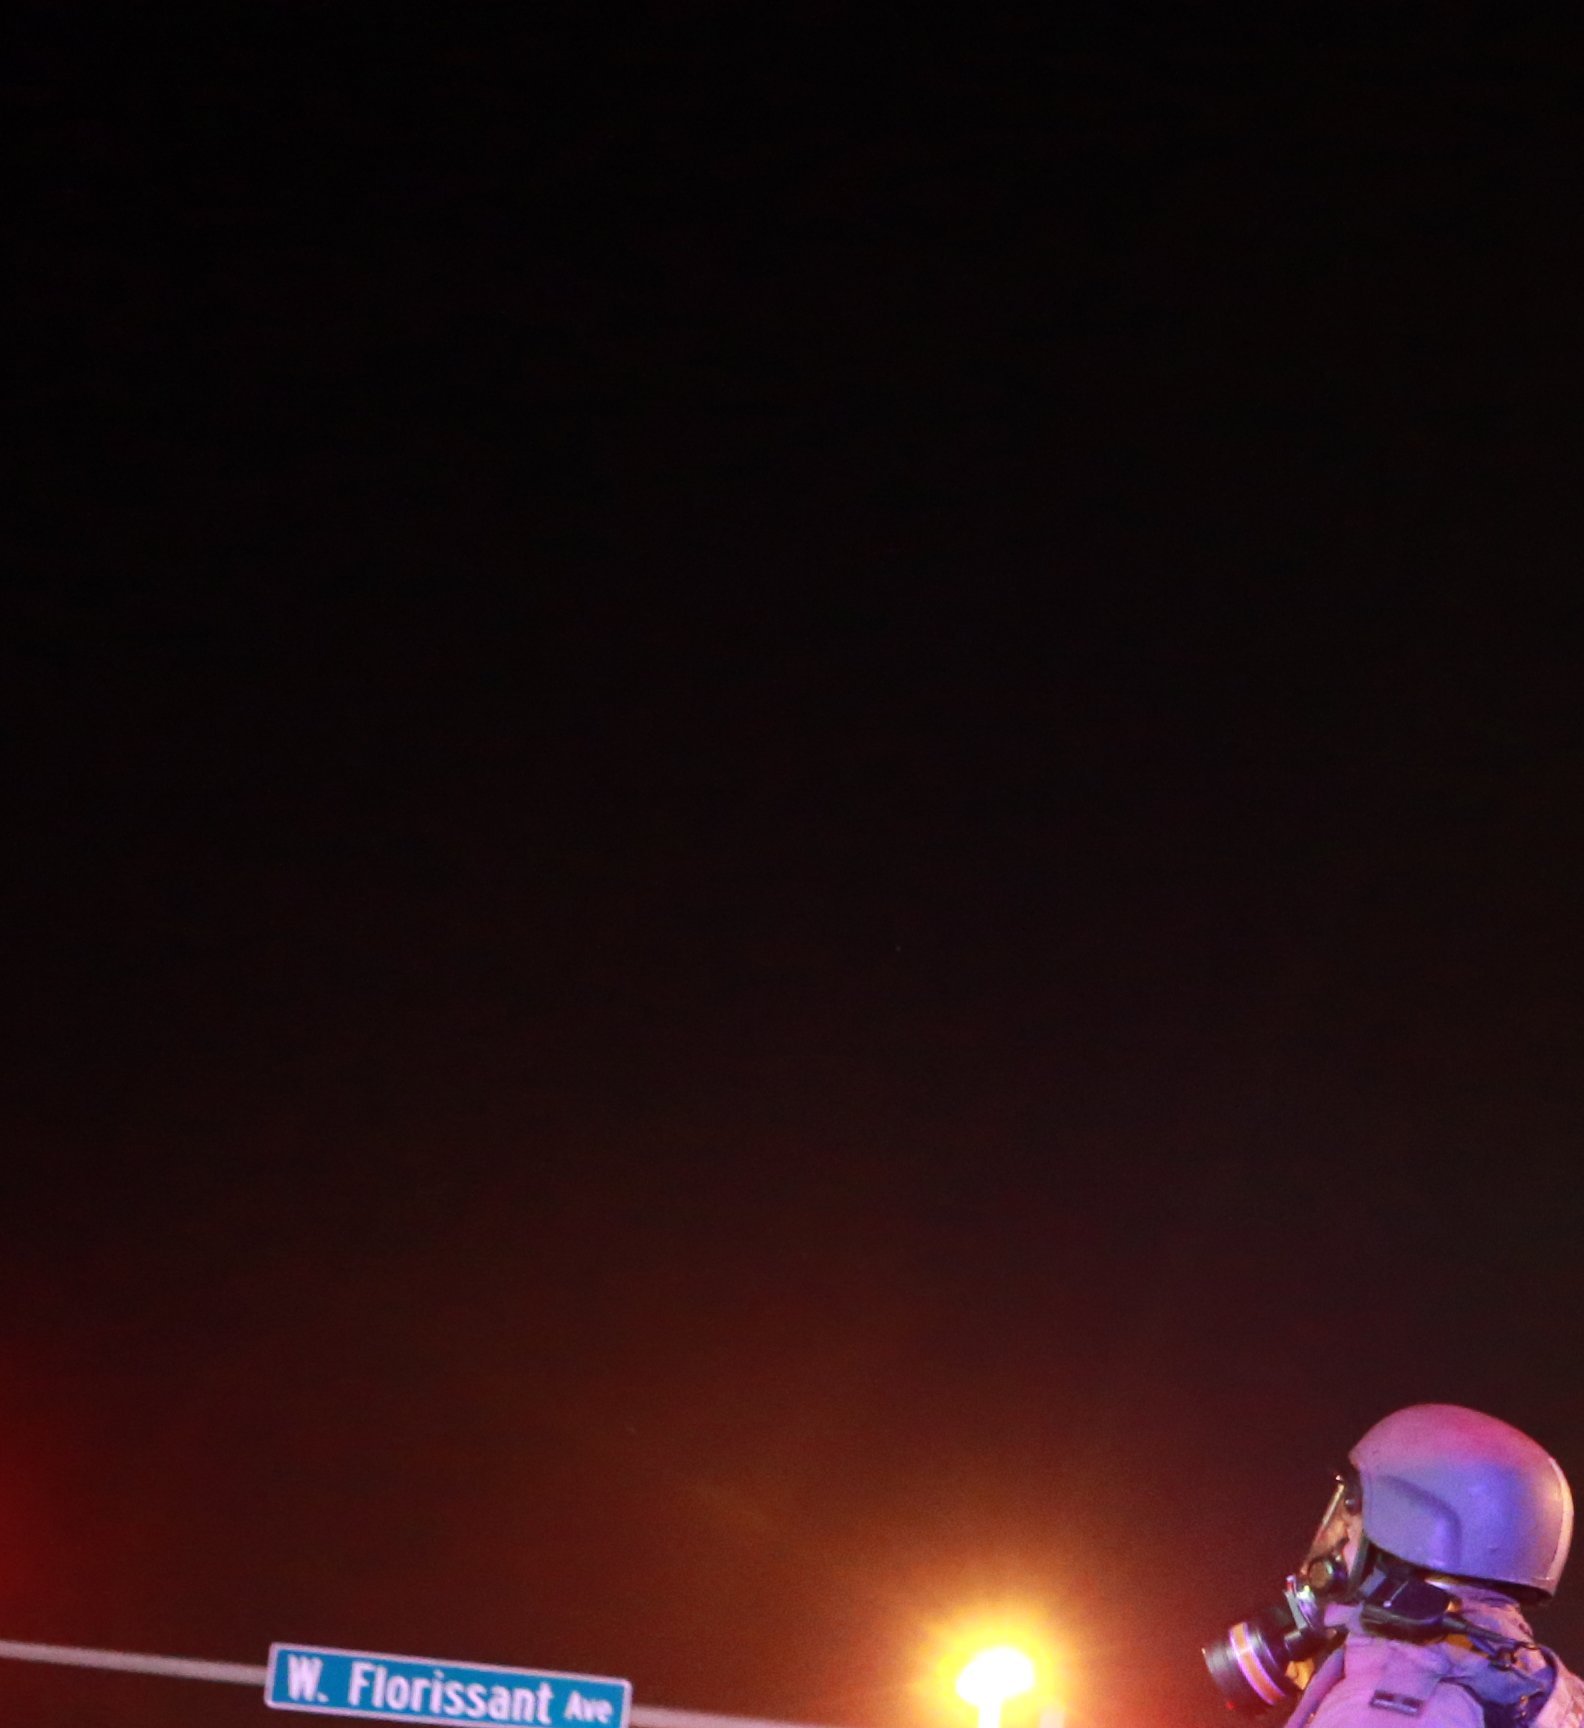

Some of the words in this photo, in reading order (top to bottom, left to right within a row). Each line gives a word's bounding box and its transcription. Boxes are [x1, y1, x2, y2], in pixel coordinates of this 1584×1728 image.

[286, 1653, 330, 1703] W.
[348, 1660, 554, 1725] Florissant
[563, 1690, 613, 1724] Ave
